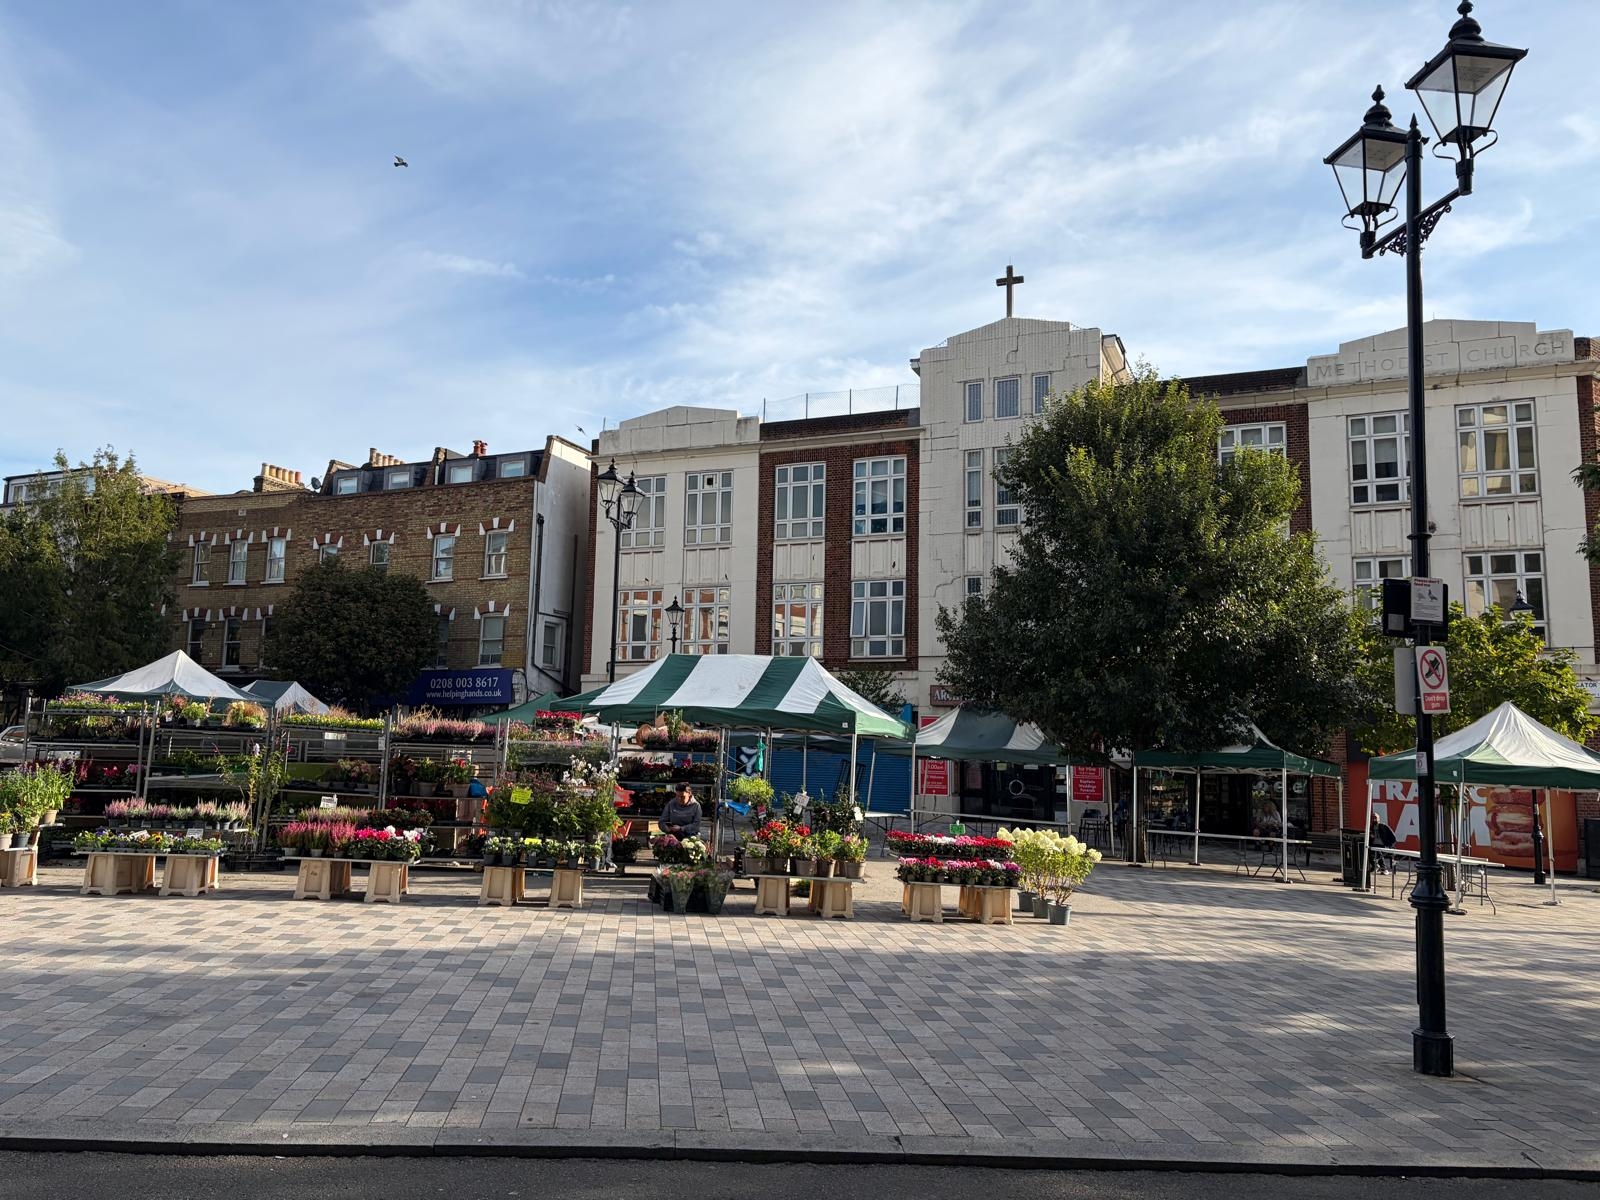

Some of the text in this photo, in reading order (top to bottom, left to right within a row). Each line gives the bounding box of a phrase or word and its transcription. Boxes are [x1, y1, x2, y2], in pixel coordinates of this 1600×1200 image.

[1315, 340, 1566, 378] METHODST CHURCH
[430, 676, 499, 689] 0208 003 8617
[426, 689, 502, 699] www.helpinghands.co.uk
